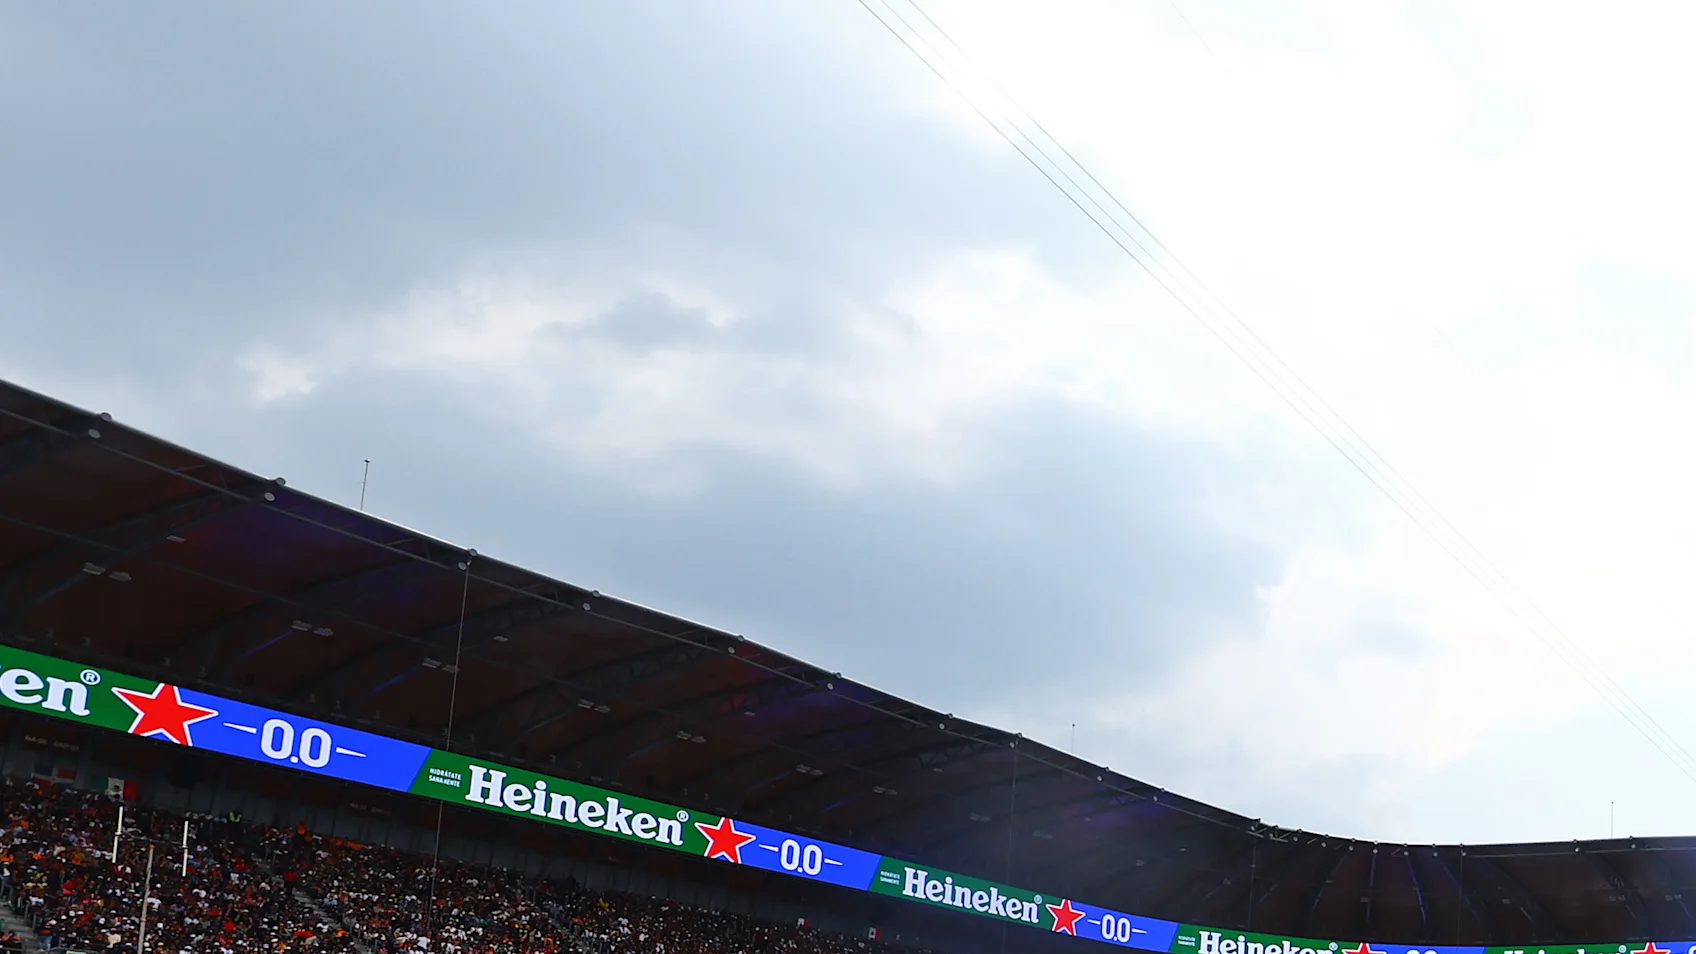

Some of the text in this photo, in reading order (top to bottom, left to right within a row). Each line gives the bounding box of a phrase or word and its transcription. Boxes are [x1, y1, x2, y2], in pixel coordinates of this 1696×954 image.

[260, 719, 332, 768] 0.0
[781, 839, 822, 875] 0.0
[1101, 914, 1131, 942] 0.0
